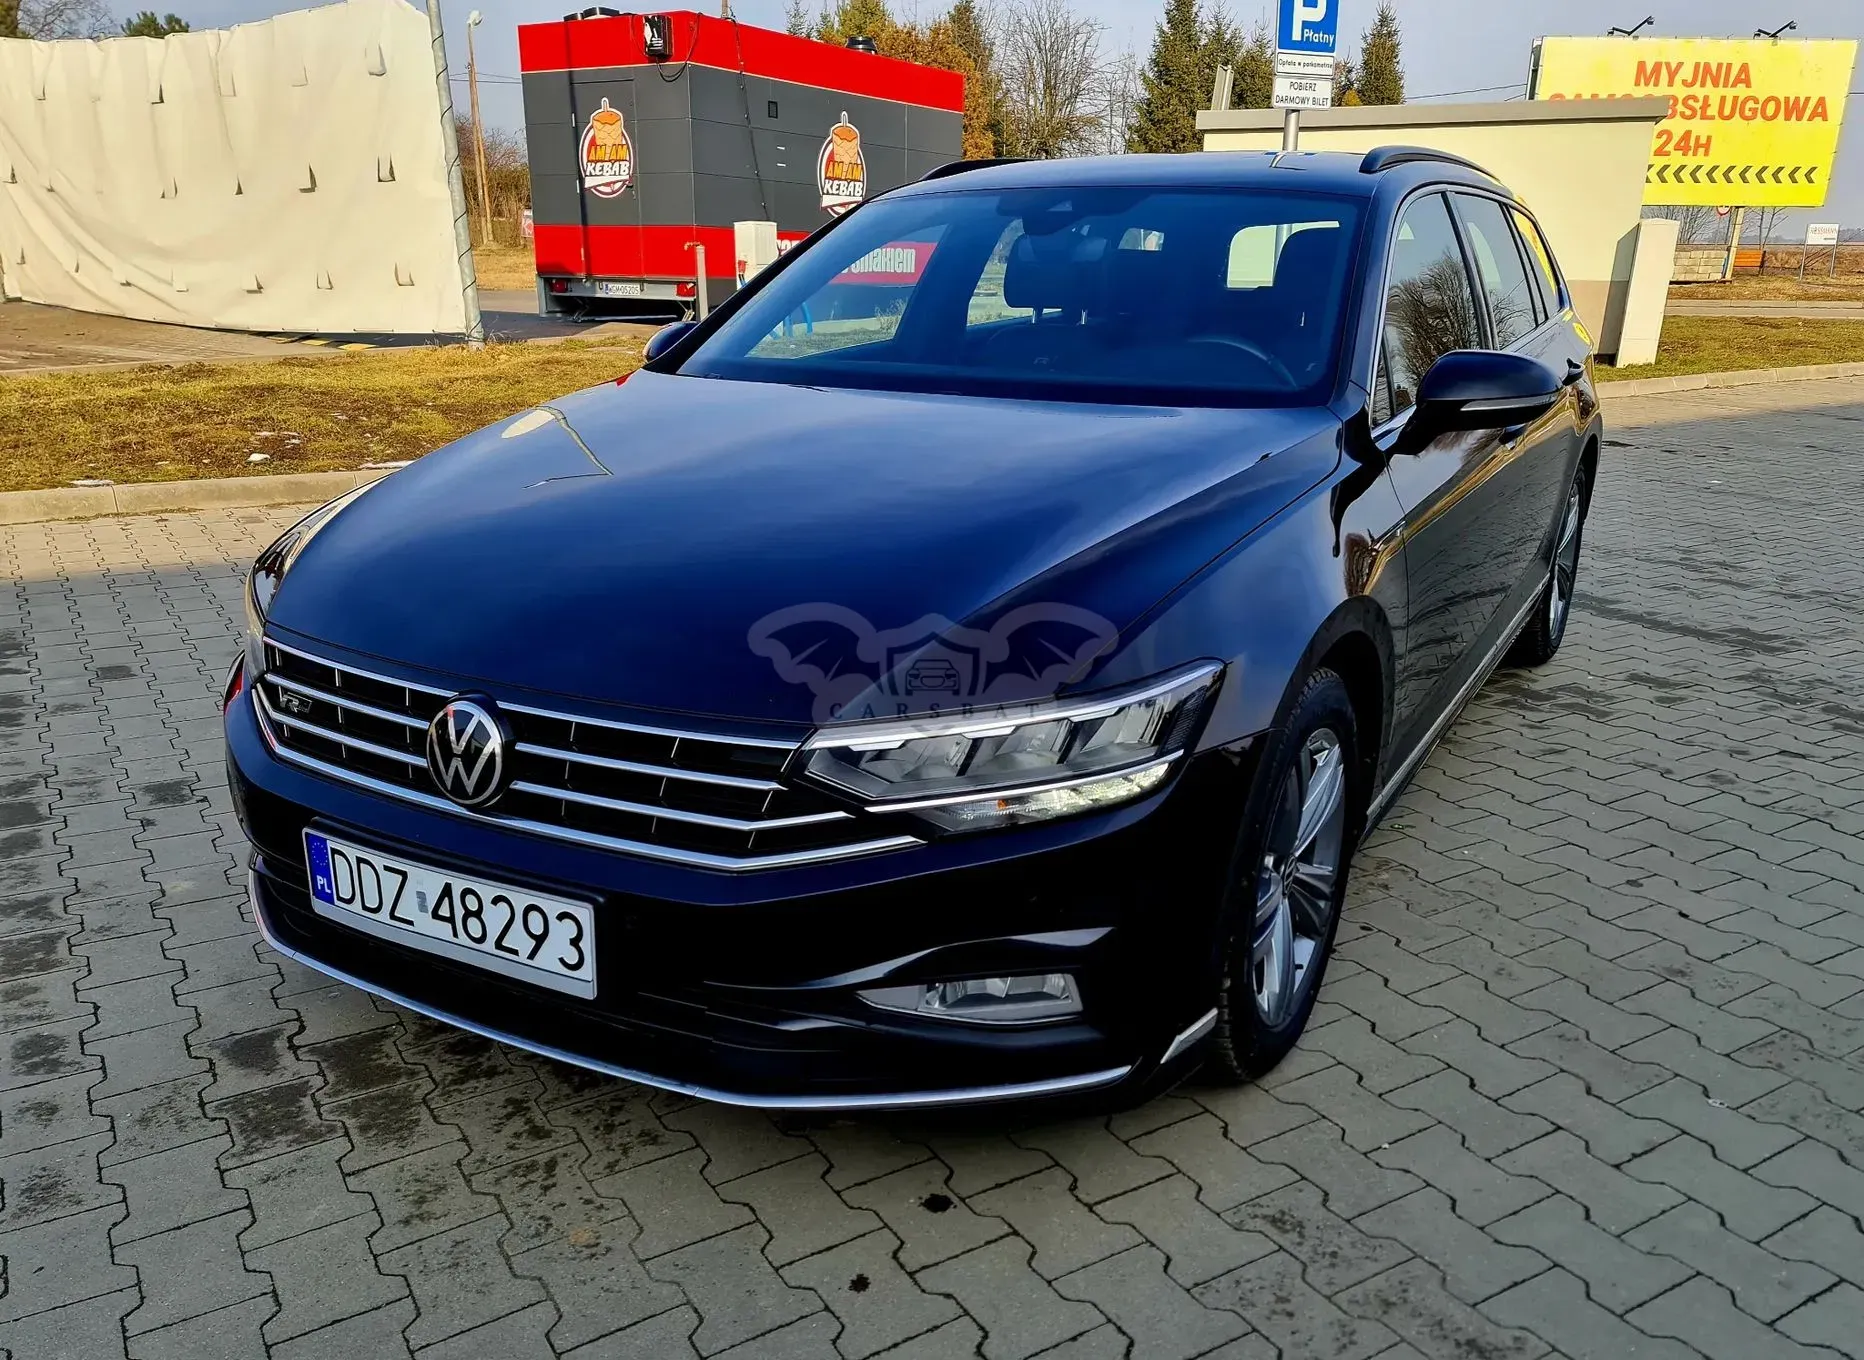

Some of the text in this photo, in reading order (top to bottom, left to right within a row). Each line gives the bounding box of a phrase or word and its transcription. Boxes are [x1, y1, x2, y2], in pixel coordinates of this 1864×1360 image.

[1291, 0, 1328, 41] P
[1303, 29, 1335, 47] Płatny
[1634, 61, 1752, 88] MYJNIA
[1289, 81, 1317, 92] POBIERZ
[1275, 94, 1329, 106] DARMOWY BILET
[1653, 129, 1713, 157] 24H
[586, 162, 630, 176] KEBAB
[823, 179, 863, 197] KEBAB
[316, 875, 332, 894] PL
[330, 846, 585, 972] DDZ 48293
